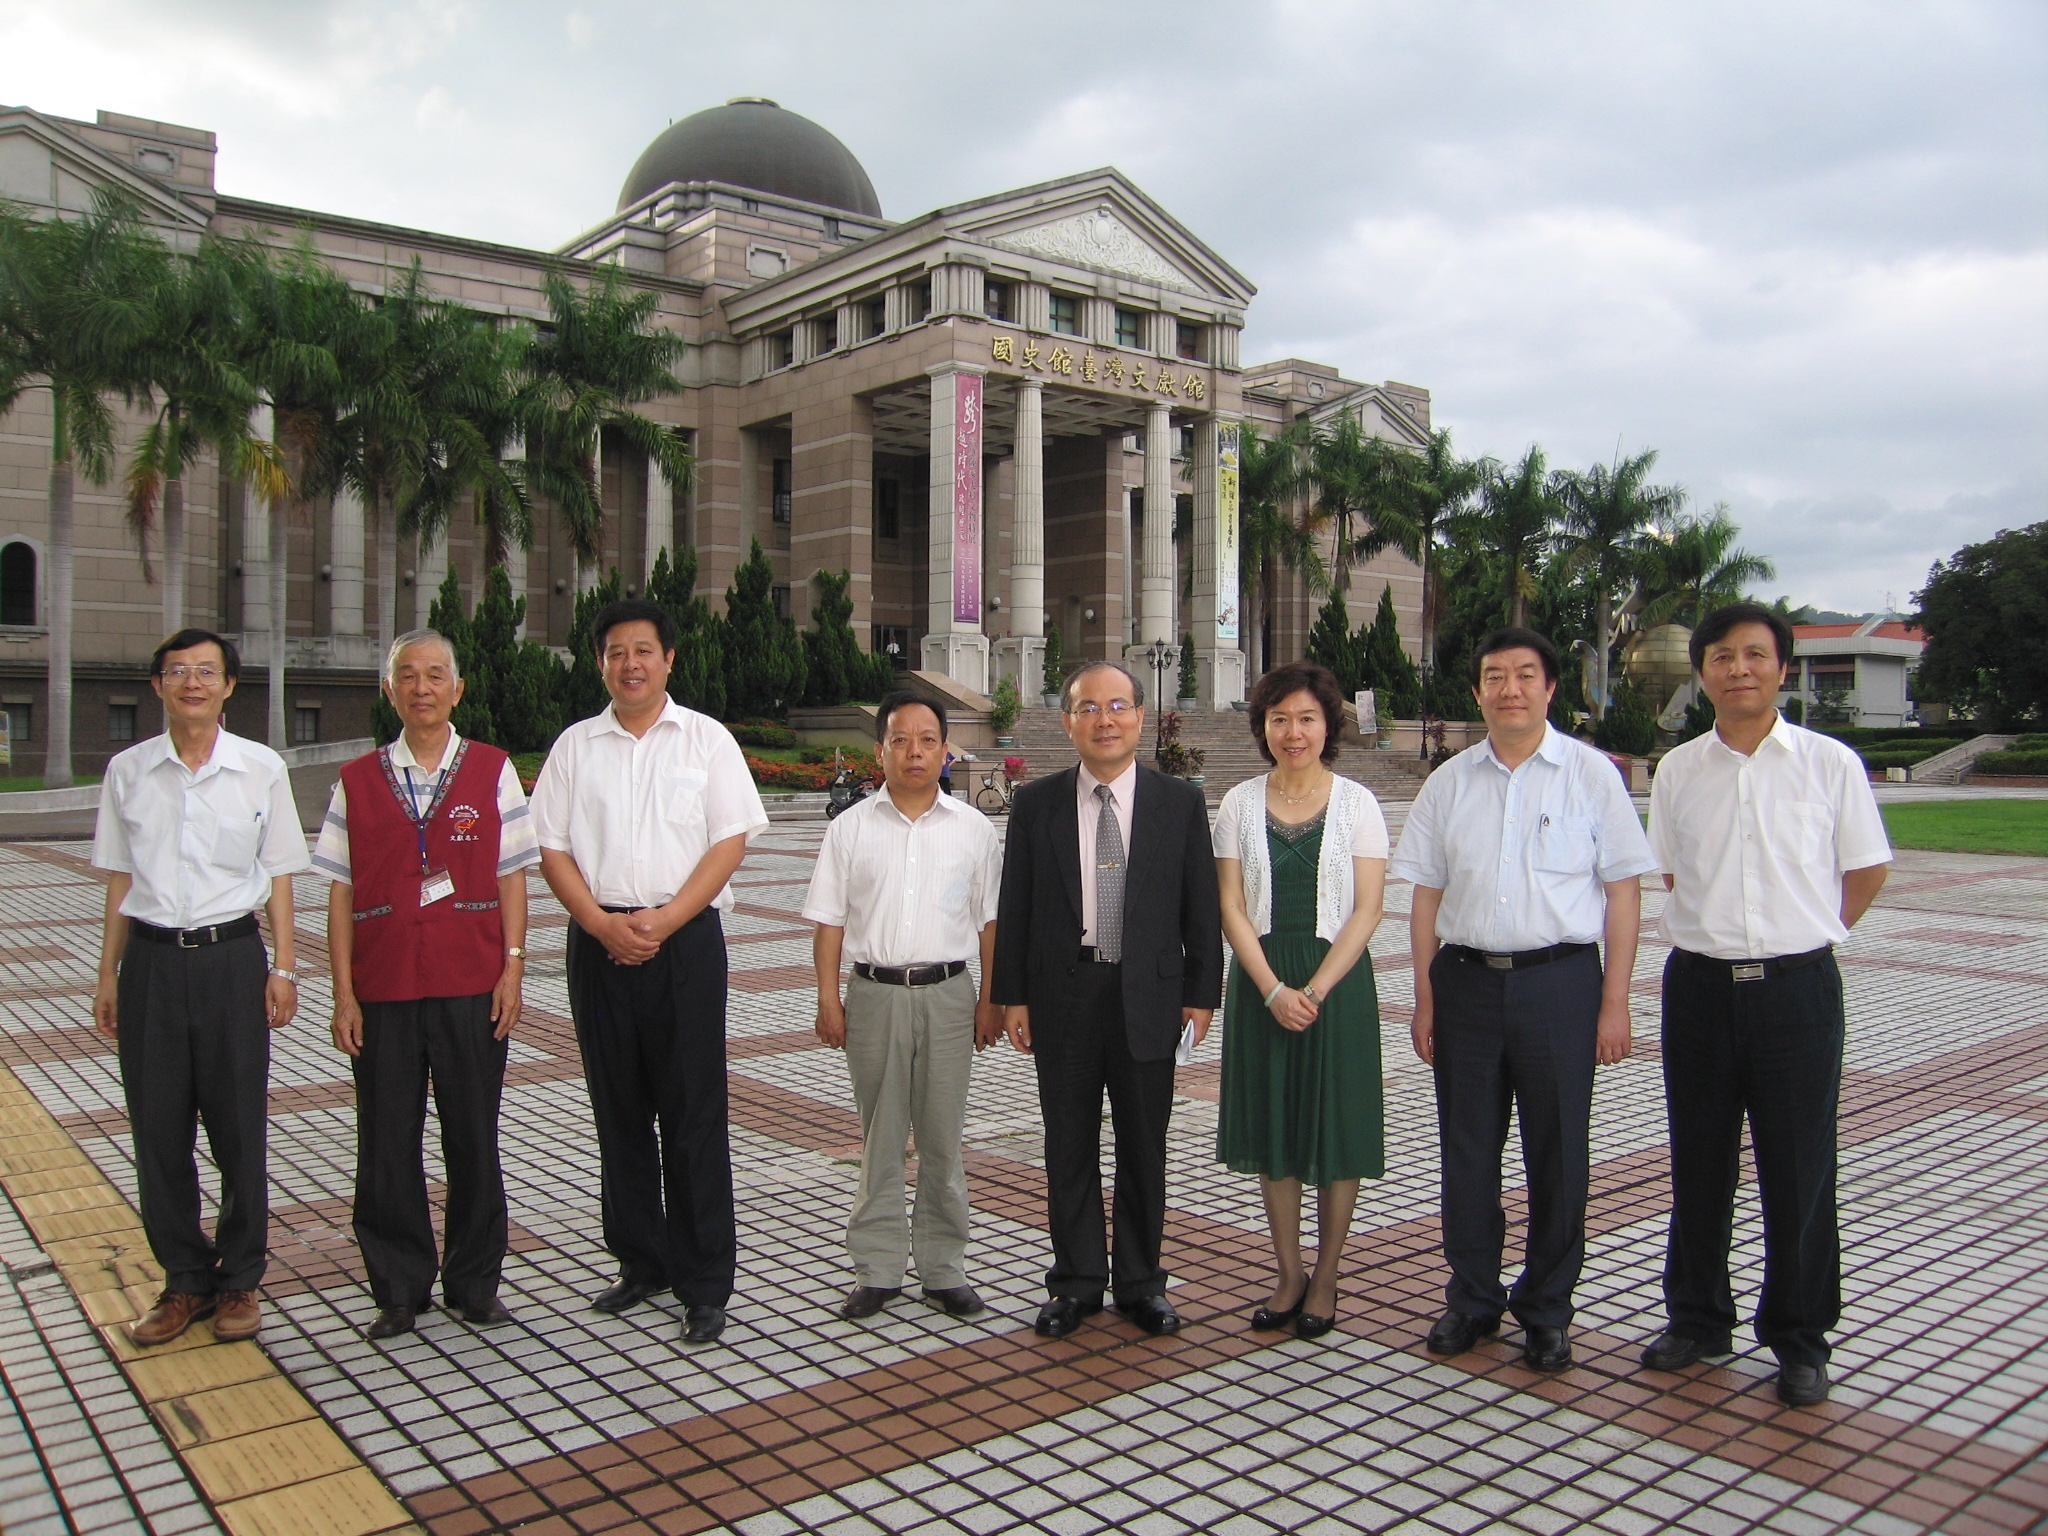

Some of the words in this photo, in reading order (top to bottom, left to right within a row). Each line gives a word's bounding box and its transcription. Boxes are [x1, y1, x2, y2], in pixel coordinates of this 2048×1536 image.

[991, 335, 1206, 400] 國史館臺灣文獻館
